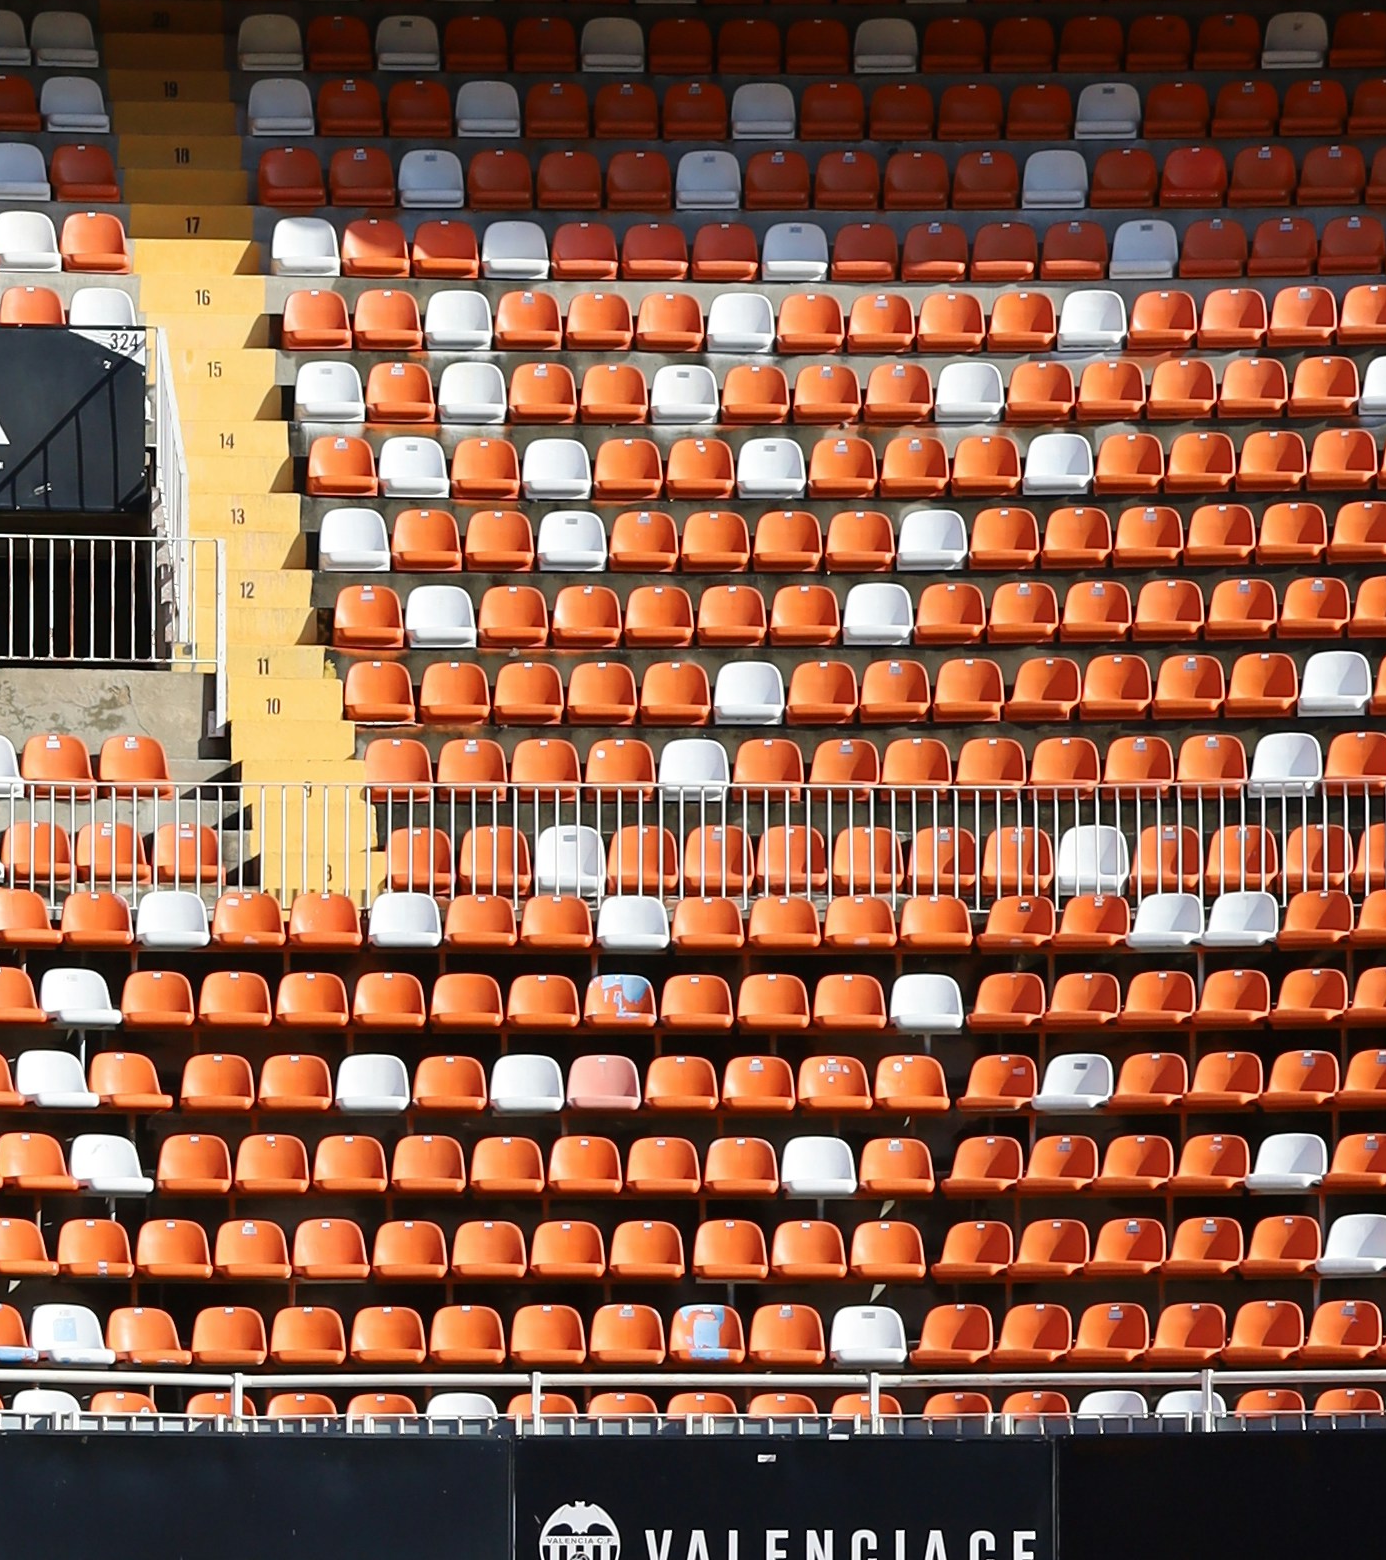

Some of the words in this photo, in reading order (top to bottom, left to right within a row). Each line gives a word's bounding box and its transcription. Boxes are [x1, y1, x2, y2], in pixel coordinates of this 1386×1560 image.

[185, 216, 201, 233] 17
[195, 290, 210, 306] 16
[110, 333, 140, 351] 324
[207, 361, 222, 378] 15
[218, 433, 235, 450] 14
[231, 508, 245, 525] 13
[240, 582, 255, 598] 12
[258, 659, 269, 675] 11
[266, 698, 281, 715] 10
